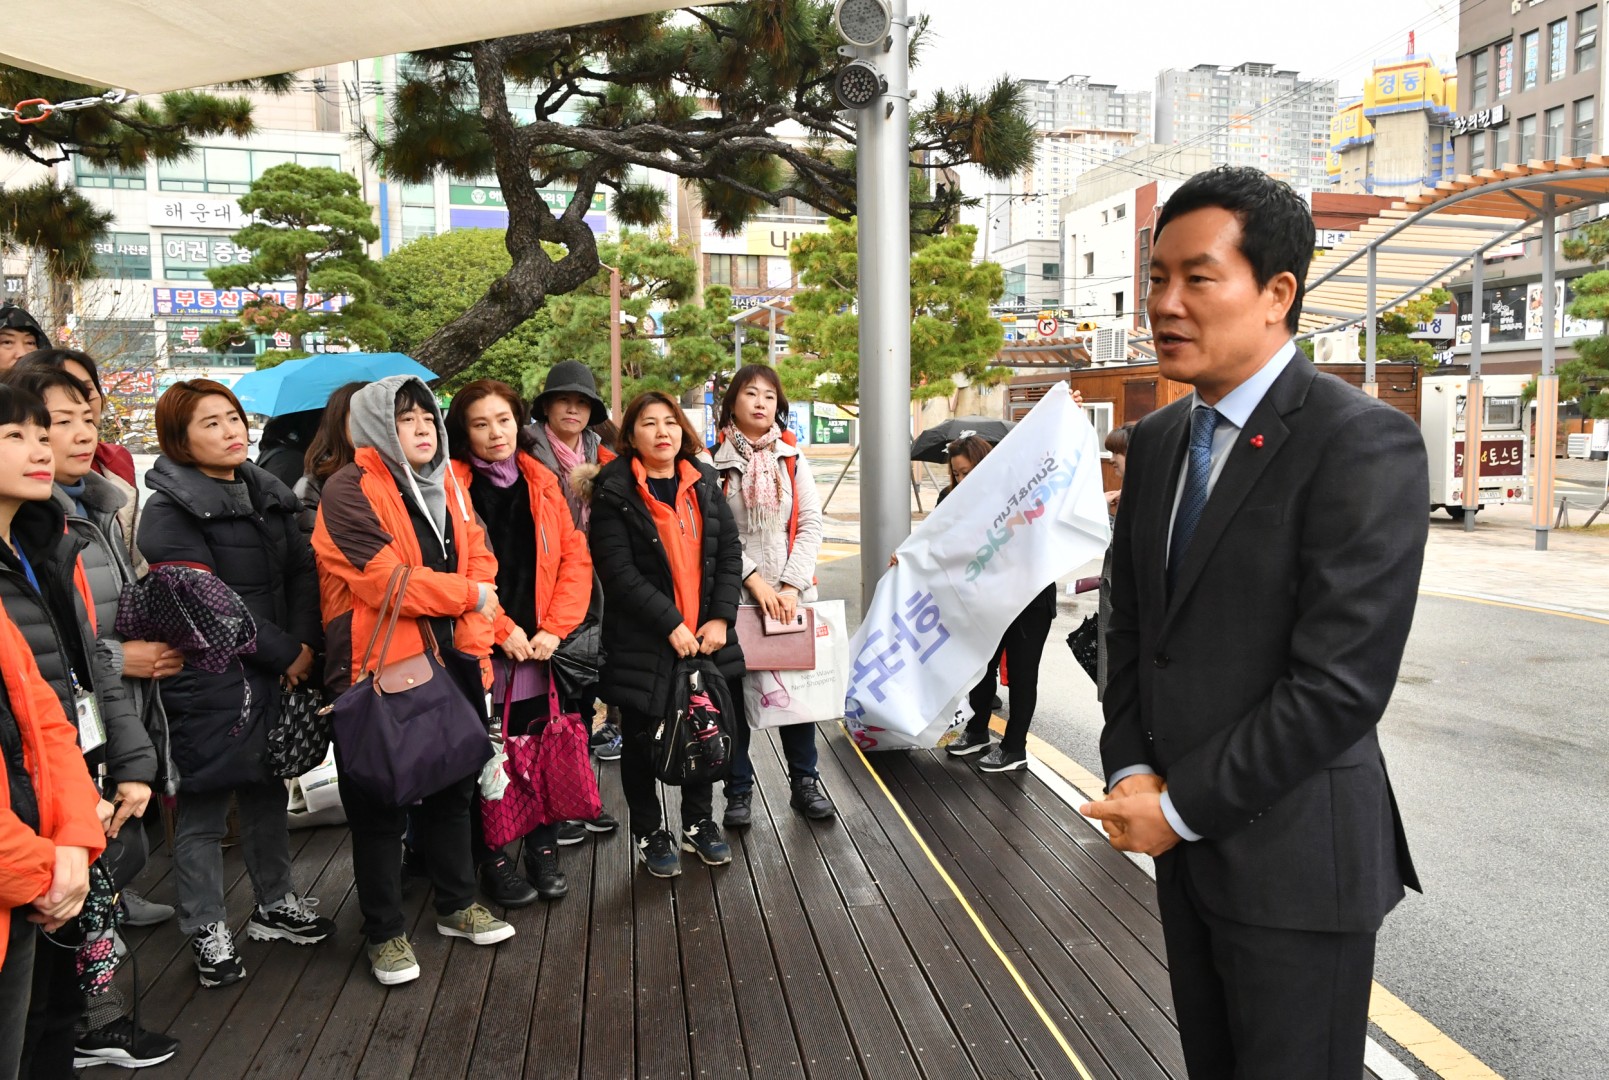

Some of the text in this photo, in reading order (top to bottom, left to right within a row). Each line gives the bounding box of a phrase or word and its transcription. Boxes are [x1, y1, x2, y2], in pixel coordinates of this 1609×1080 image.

[1379, 71, 1421, 95] 경동
[594, 193, 604, 203] 4F
[117, 244, 148, 256] 사진관
[166, 240, 208, 262] 여권
